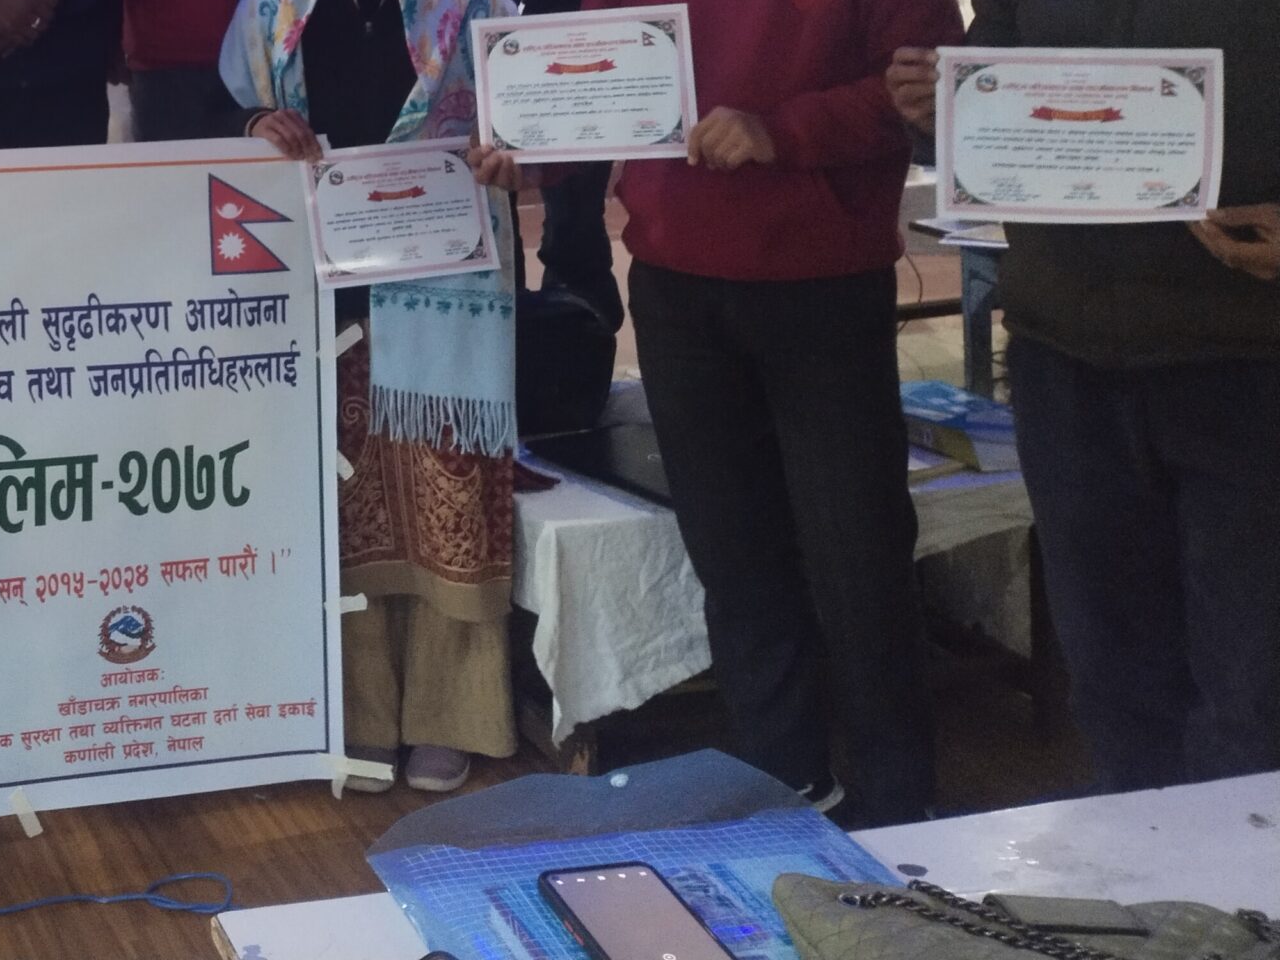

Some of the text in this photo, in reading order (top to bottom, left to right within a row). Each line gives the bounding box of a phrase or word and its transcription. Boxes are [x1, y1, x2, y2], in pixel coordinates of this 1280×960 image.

[185, 288, 290, 332] आयोजना
[26, 367, 75, 403] तथा
[36, 565, 148, 603] २०१५-२०२४
[160, 558, 210, 586] सफल
[128, 684, 209, 709] नगरपालिका
[21, 728, 62, 750] सुरक्षा
[68, 723, 96, 740] तथा
[103, 715, 164, 733] व्यक्तिगत
[170, 712, 207, 727] घटना
[213, 704, 239, 726] दर्ता
[245, 703, 271, 720] सेवा
[278, 698, 317, 718] इकाई
[64, 742, 115, 763] कर्णाली
[167, 736, 204, 751] नेपाल
